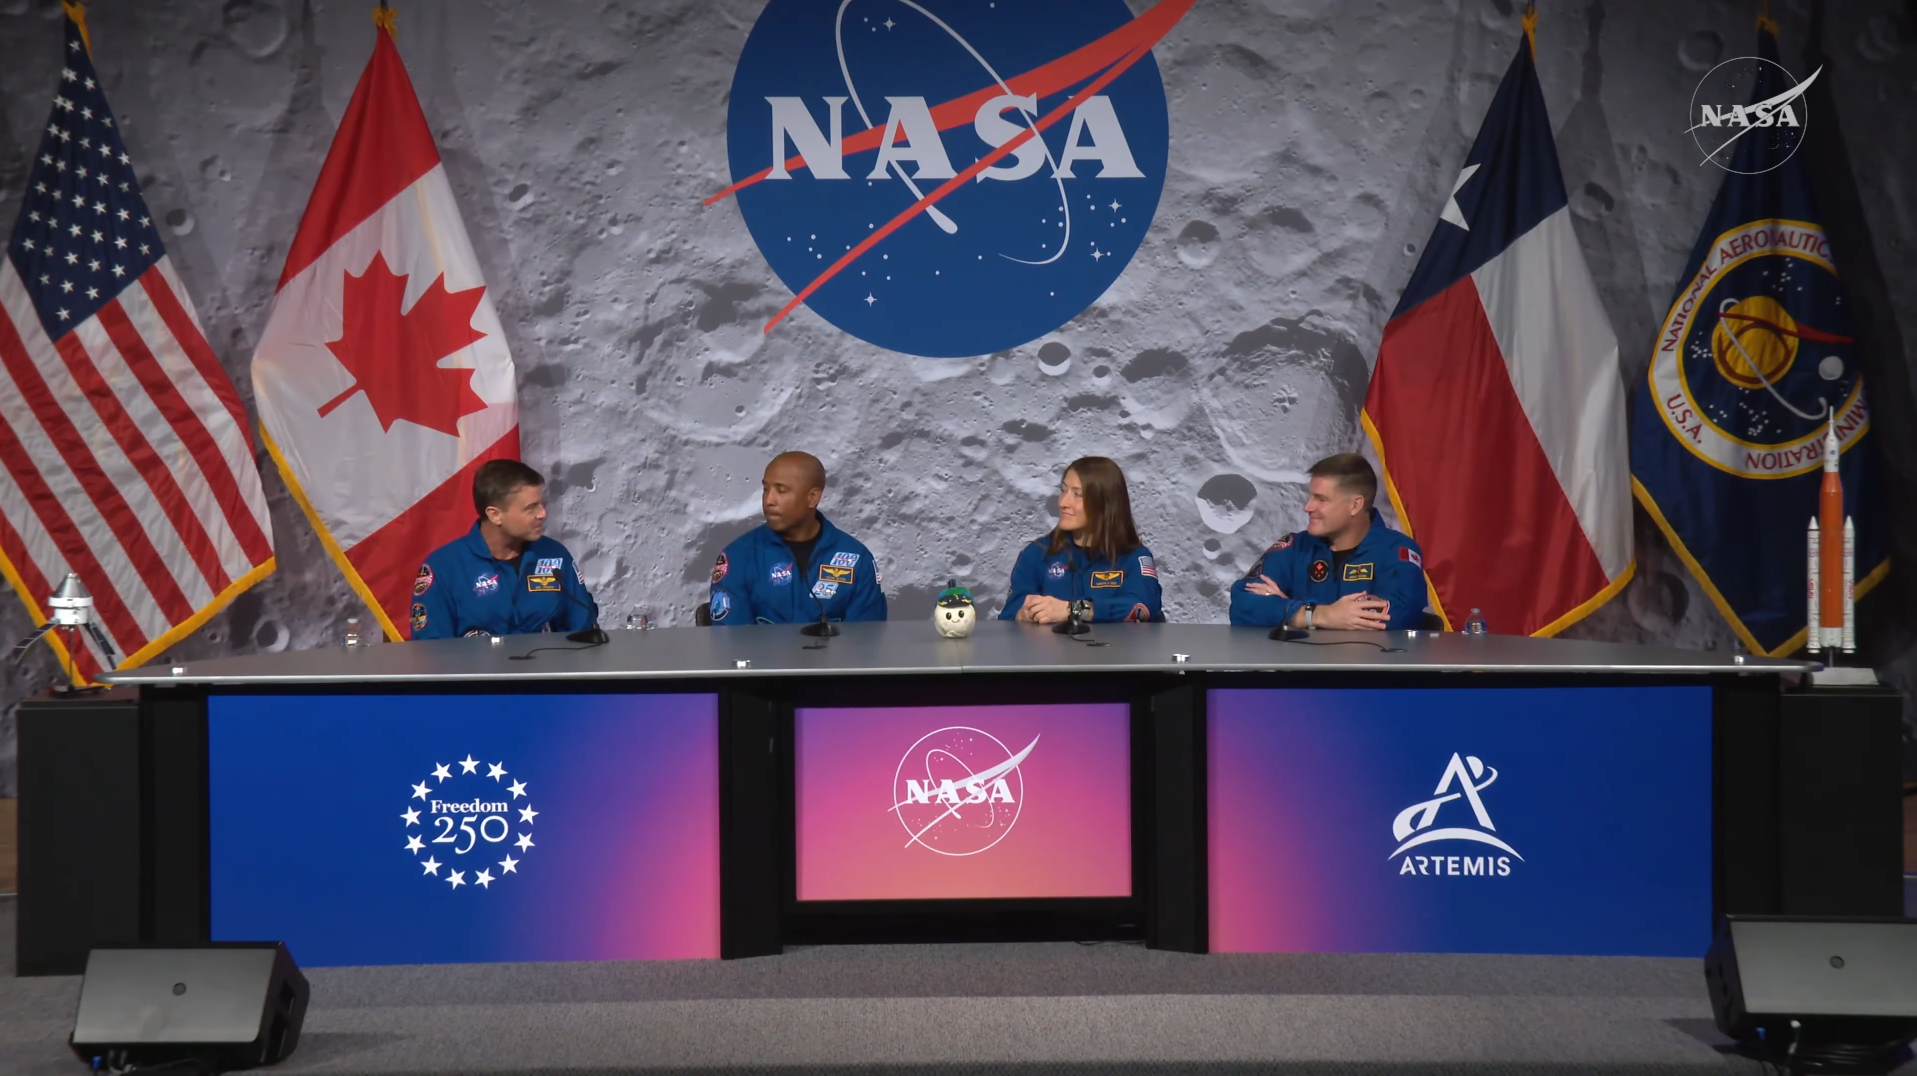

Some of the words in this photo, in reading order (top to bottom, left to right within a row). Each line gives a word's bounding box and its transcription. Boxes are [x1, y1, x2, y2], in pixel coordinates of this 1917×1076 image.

[764, 93, 1147, 183] NASA
[1661, 265, 1718, 352] NATIONAL
[1719, 228, 1833, 266] AEROAUTIC
[1667, 394, 1703, 444] U.S.A.
[475, 579, 498, 589] NASA
[771, 570, 792, 579] NASA
[905, 778, 1016, 804] NASA
[430, 798, 509, 814] Freedom
[431, 814, 509, 855] 250
[1399, 856, 1511, 876] ARTEMIS
